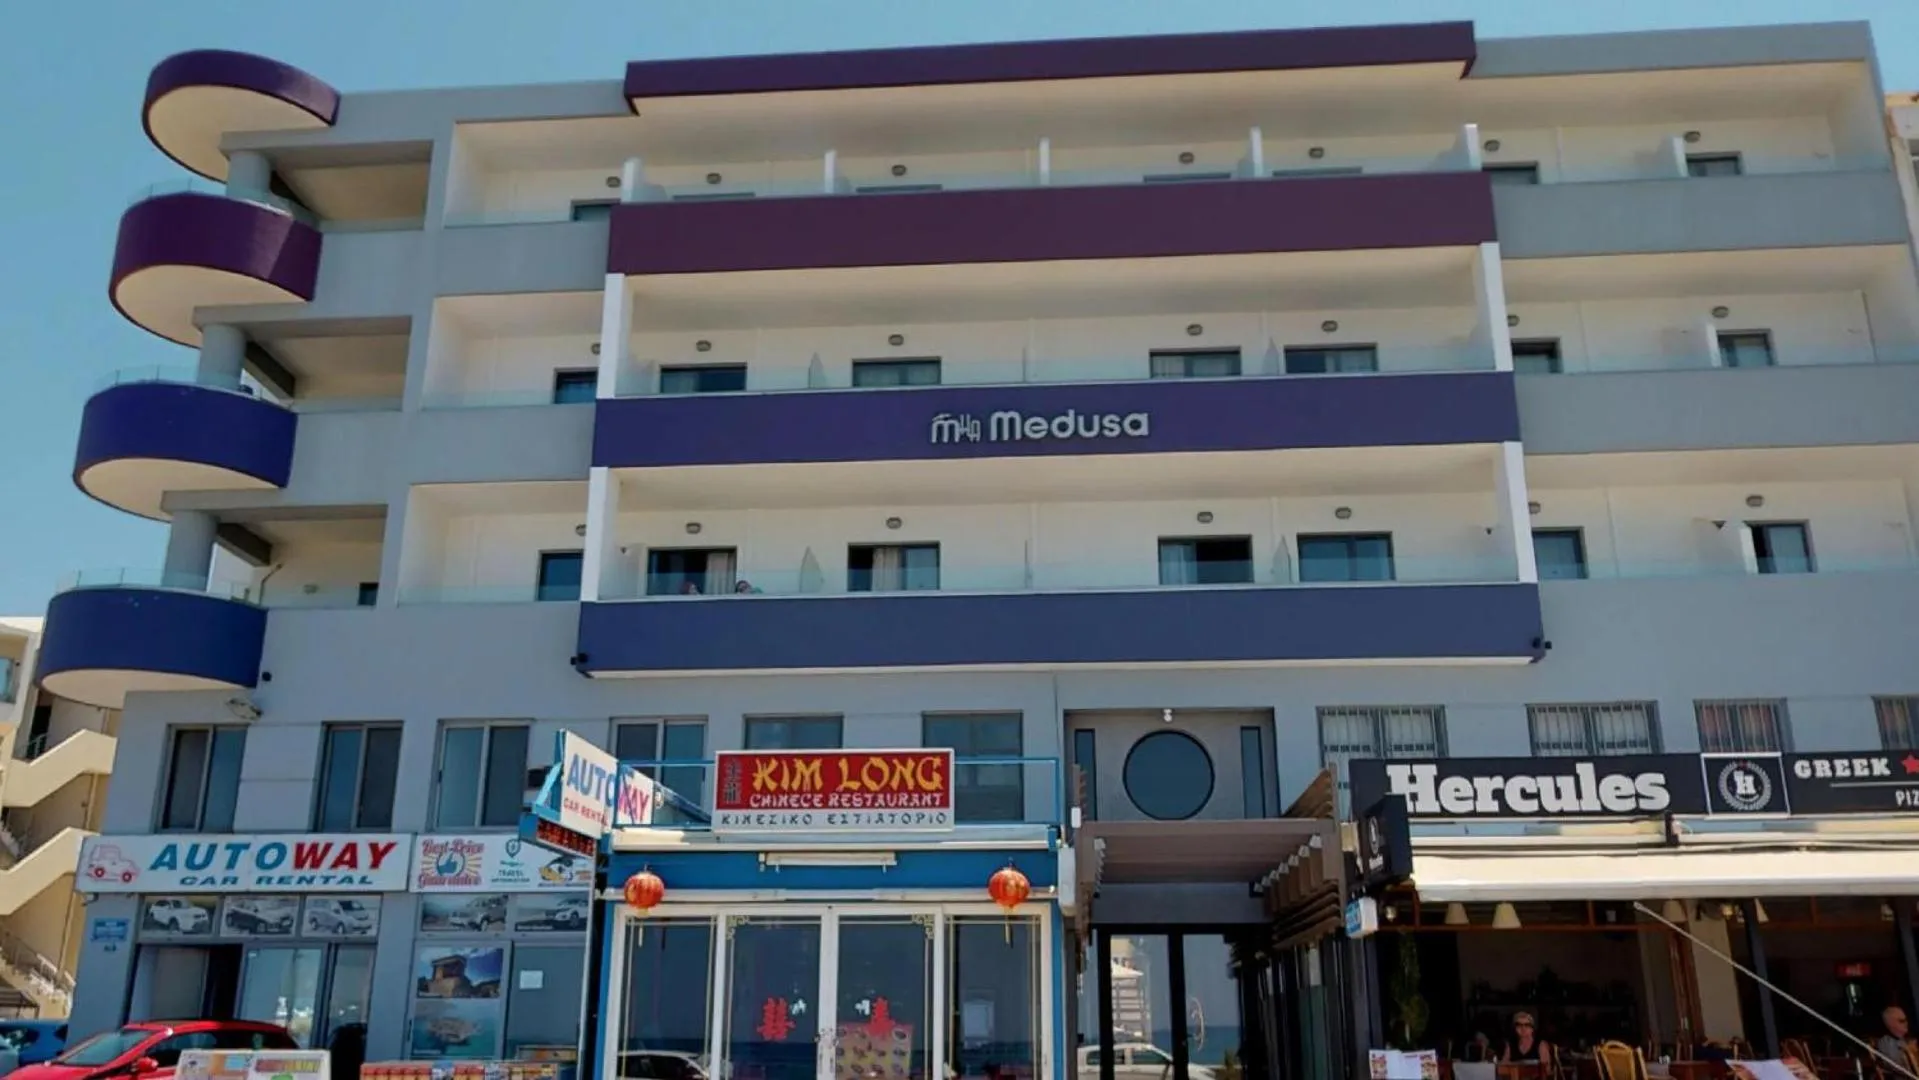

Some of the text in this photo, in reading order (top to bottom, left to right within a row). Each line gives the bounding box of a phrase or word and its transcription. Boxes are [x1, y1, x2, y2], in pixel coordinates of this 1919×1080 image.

[990, 409, 1149, 441] Medusa
[752, 756, 823, 791] KIM
[836, 756, 944, 791] LONG
[1793, 758, 1892, 779] GREEK
[828, 792, 943, 807] RESTAURANT
[1385, 762, 1671, 814] Hercules
[148, 842, 398, 871] AUTOWAY
[179, 875, 374, 887] CAR RENTAL
